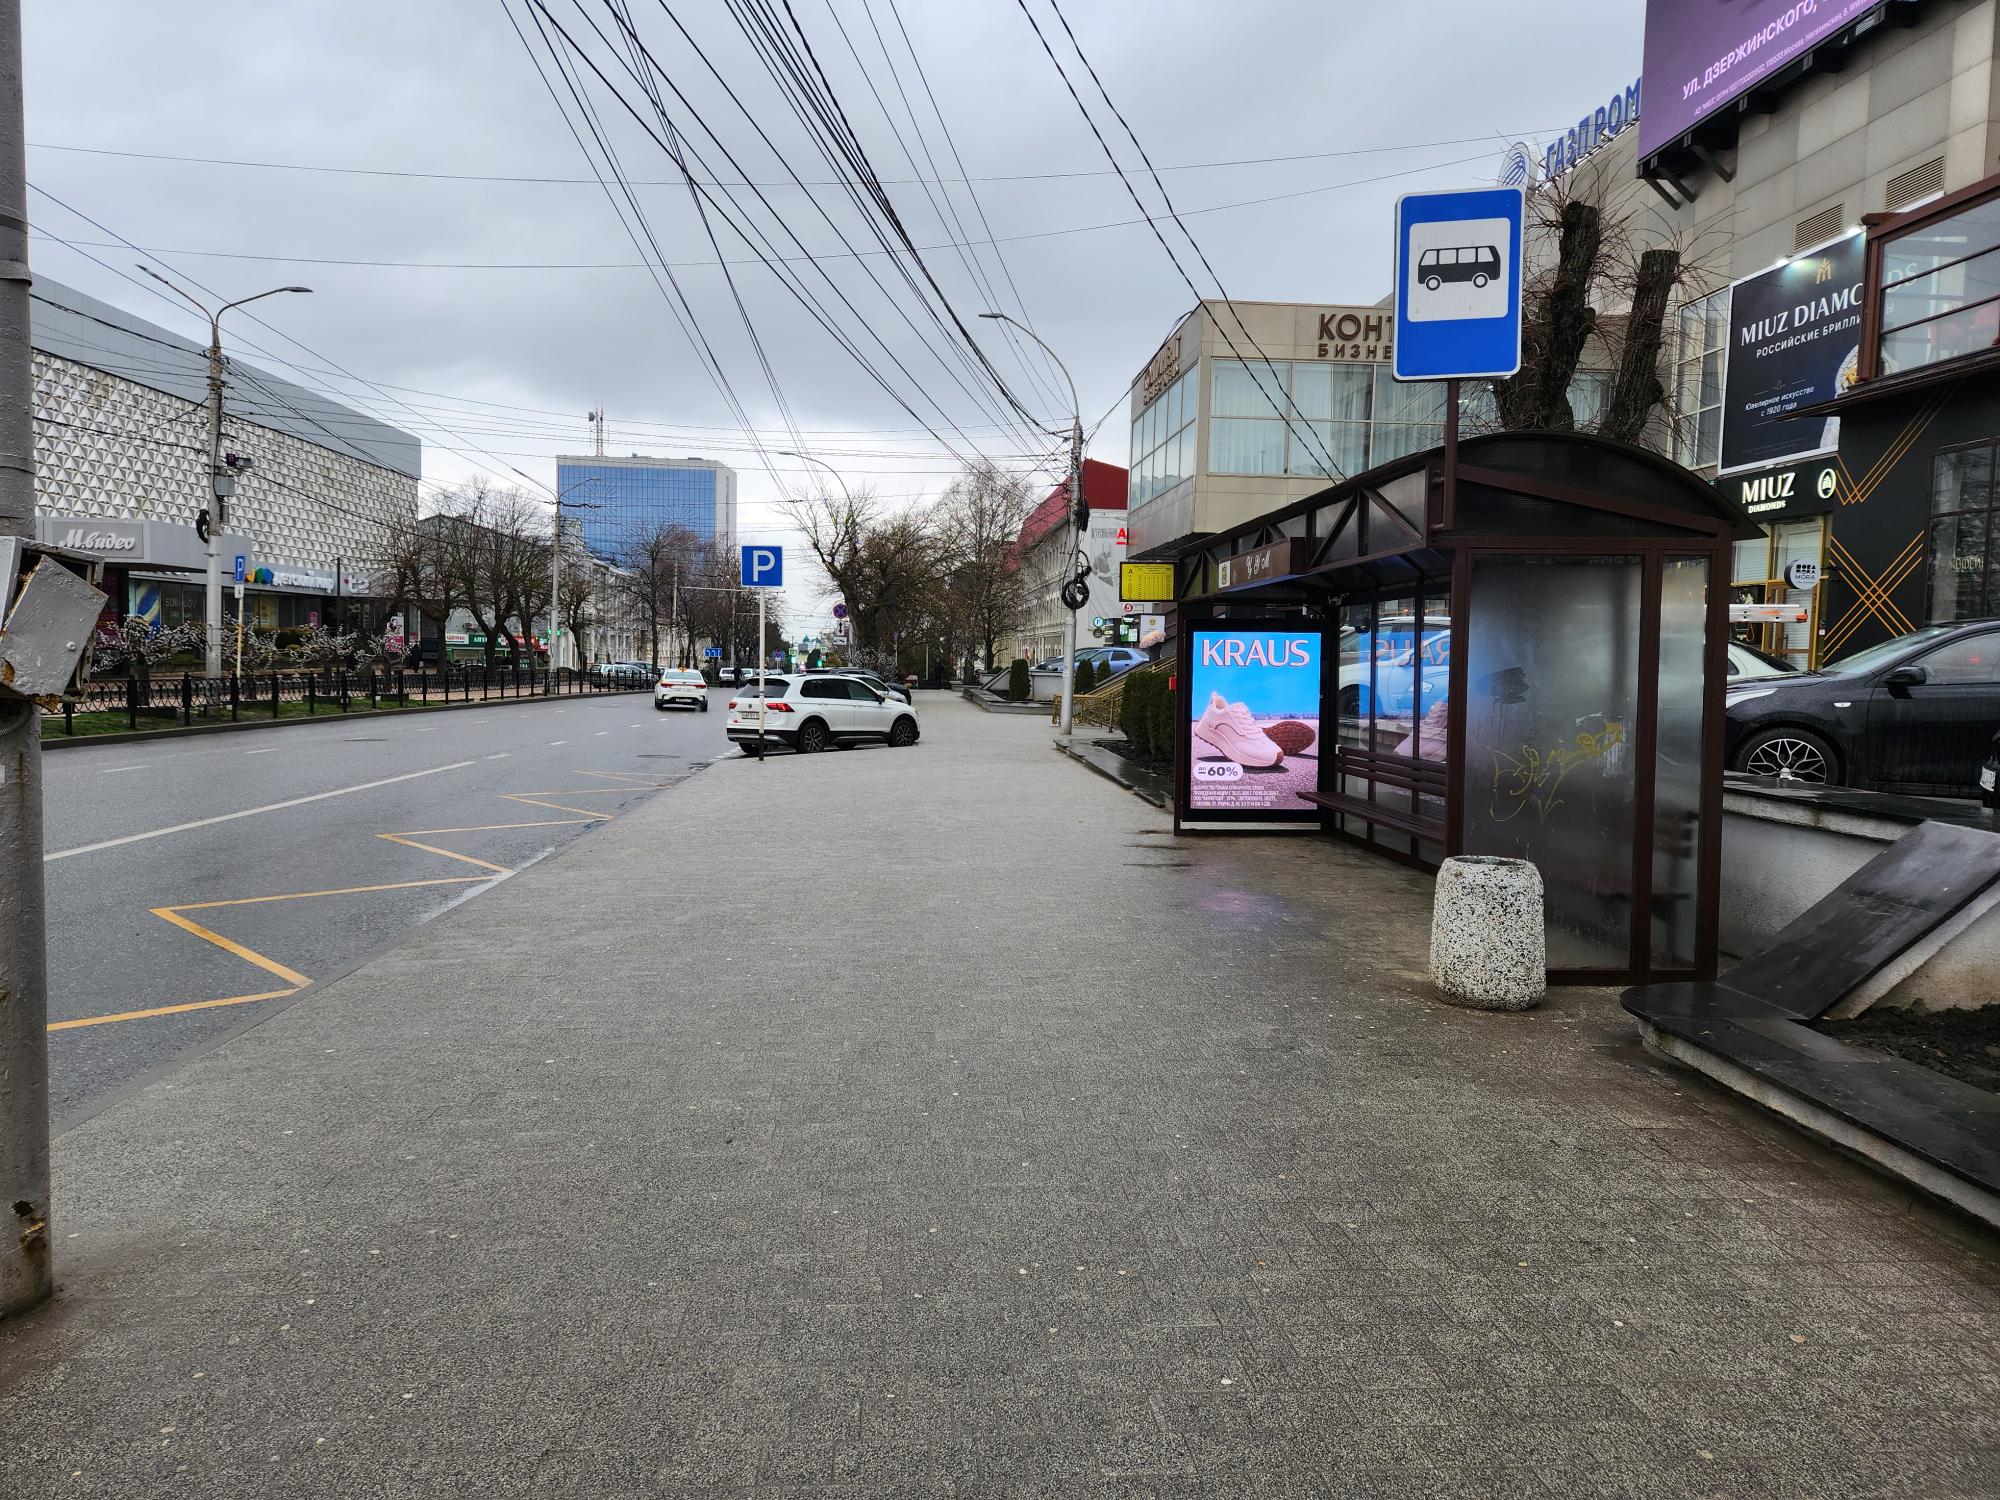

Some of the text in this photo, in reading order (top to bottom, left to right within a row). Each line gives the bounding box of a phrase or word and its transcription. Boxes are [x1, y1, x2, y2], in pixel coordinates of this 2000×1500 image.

[1682, 0, 1818, 100] УЛ. ДЗЕРЖИНСКОГО,
[1545, 76, 1641, 179] ГАЗПРОМ
[1741, 311, 1789, 346] MIUZ
[1756, 328, 1820, 359] РОССИЙСКИЕ
[1744, 386, 1815, 411] Ювелирное искусство
[1767, 404, 1781, 416] 1920
[1782, 402, 1798, 411] года
[1742, 472, 1796, 504] MIUZ
[1748, 500, 1787, 514] DIAMONDS
[58, 529, 136, 551] М.видео
[752, 550, 776, 582] P
[1202, 639, 1310, 667] KRAUS
